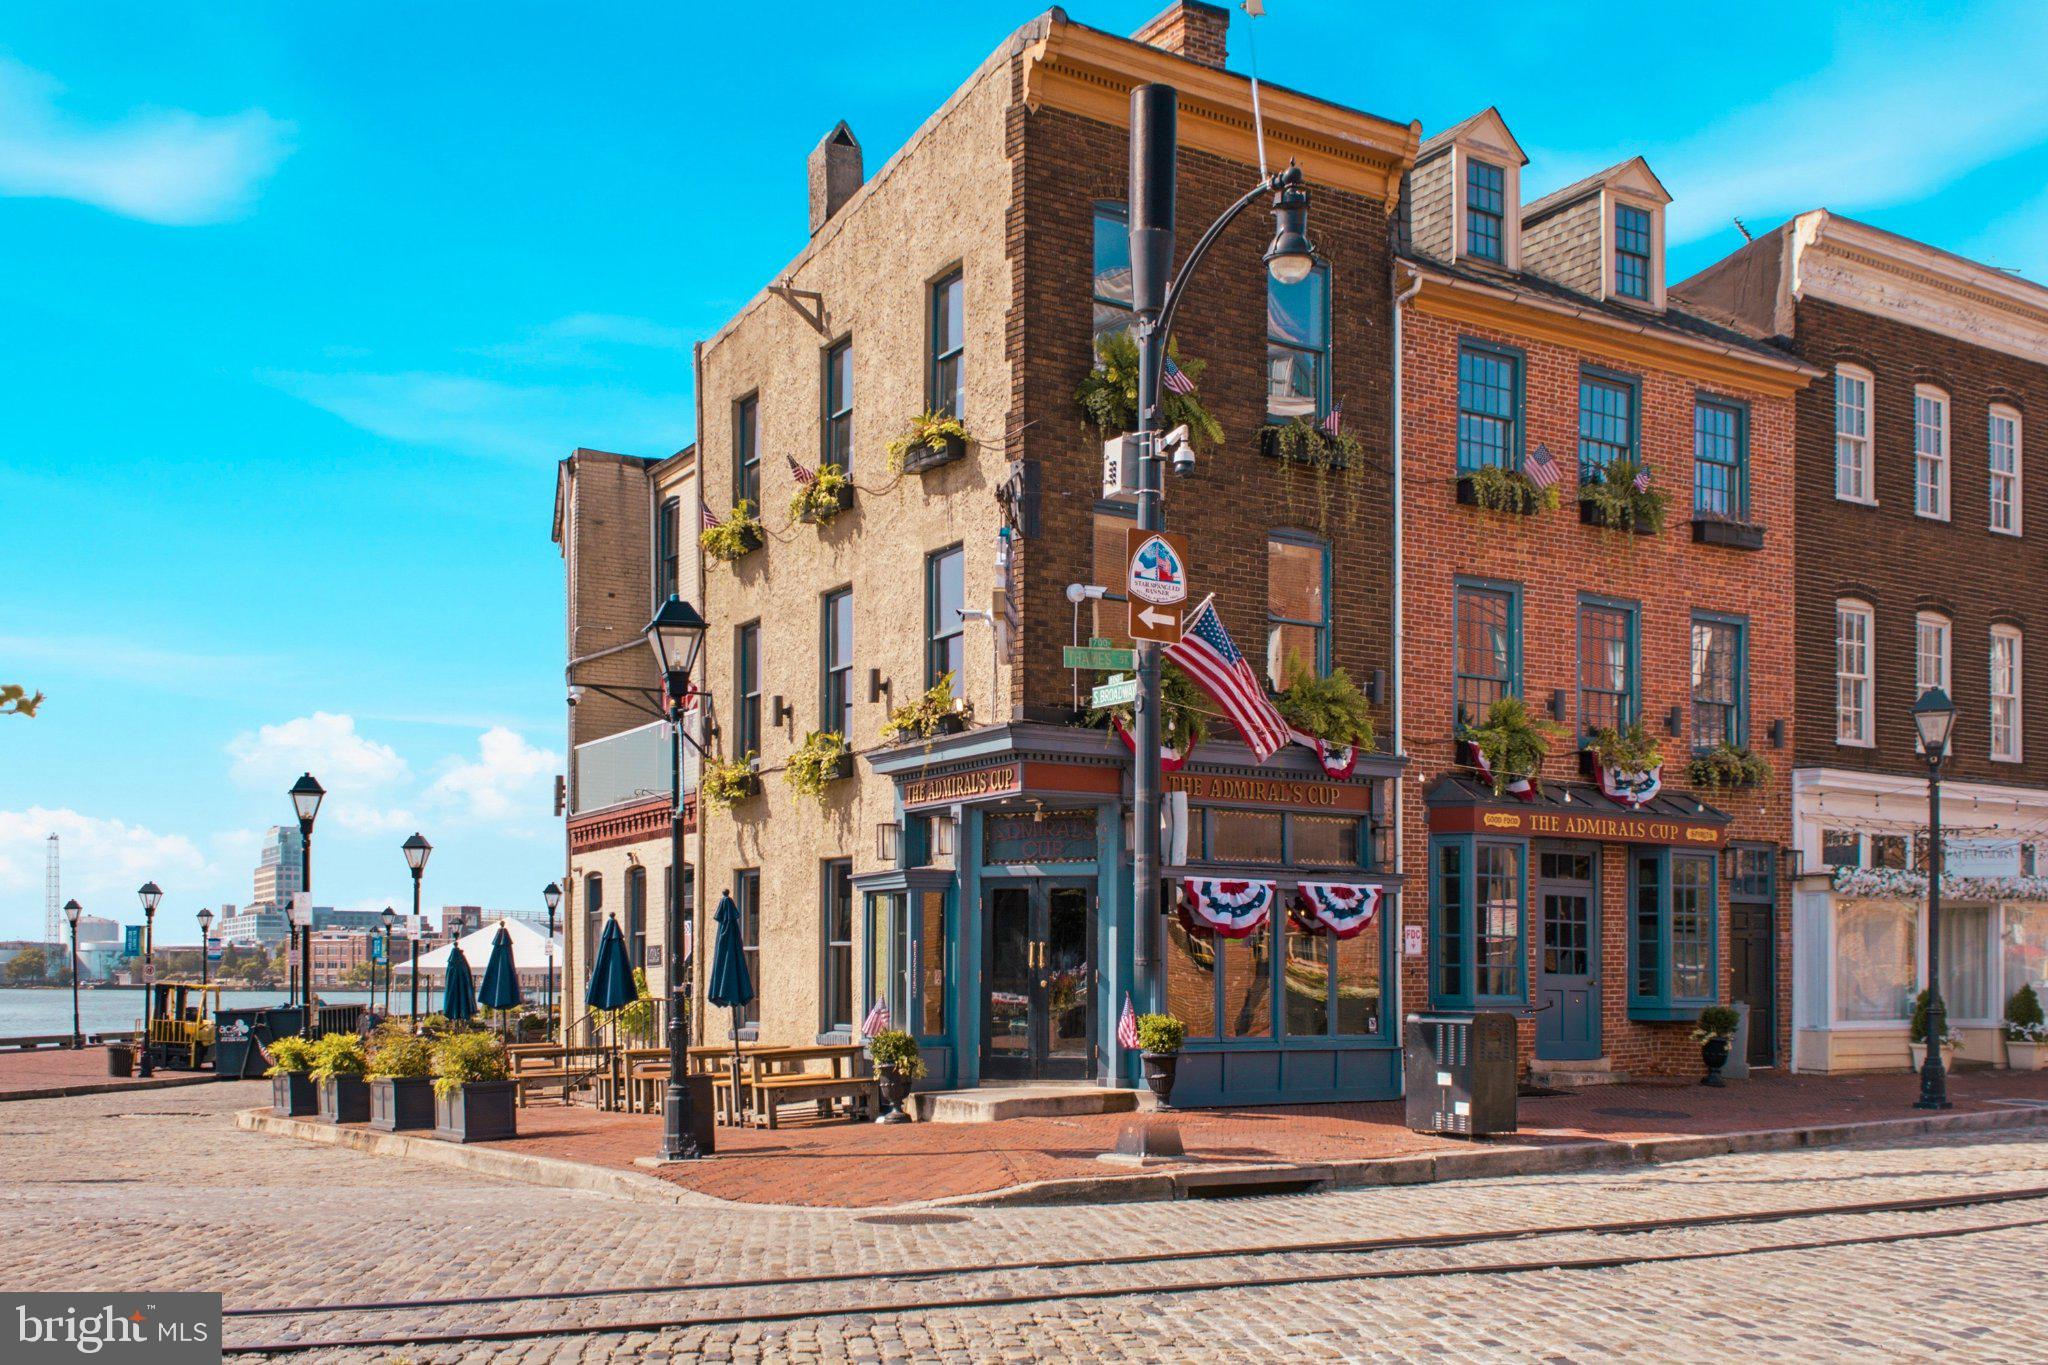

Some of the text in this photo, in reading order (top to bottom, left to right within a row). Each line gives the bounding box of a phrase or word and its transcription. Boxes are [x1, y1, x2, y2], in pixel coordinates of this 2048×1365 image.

[907, 768, 1013, 804] THE ADMIRAL'S CUP
[1168, 776, 1340, 805] THE ADMIRAL'S CUP
[1529, 815, 1679, 840] THE ADMIRALS CUP
[1022, 840, 1064, 858] CUP
[1406, 929, 1421, 939] FDC
